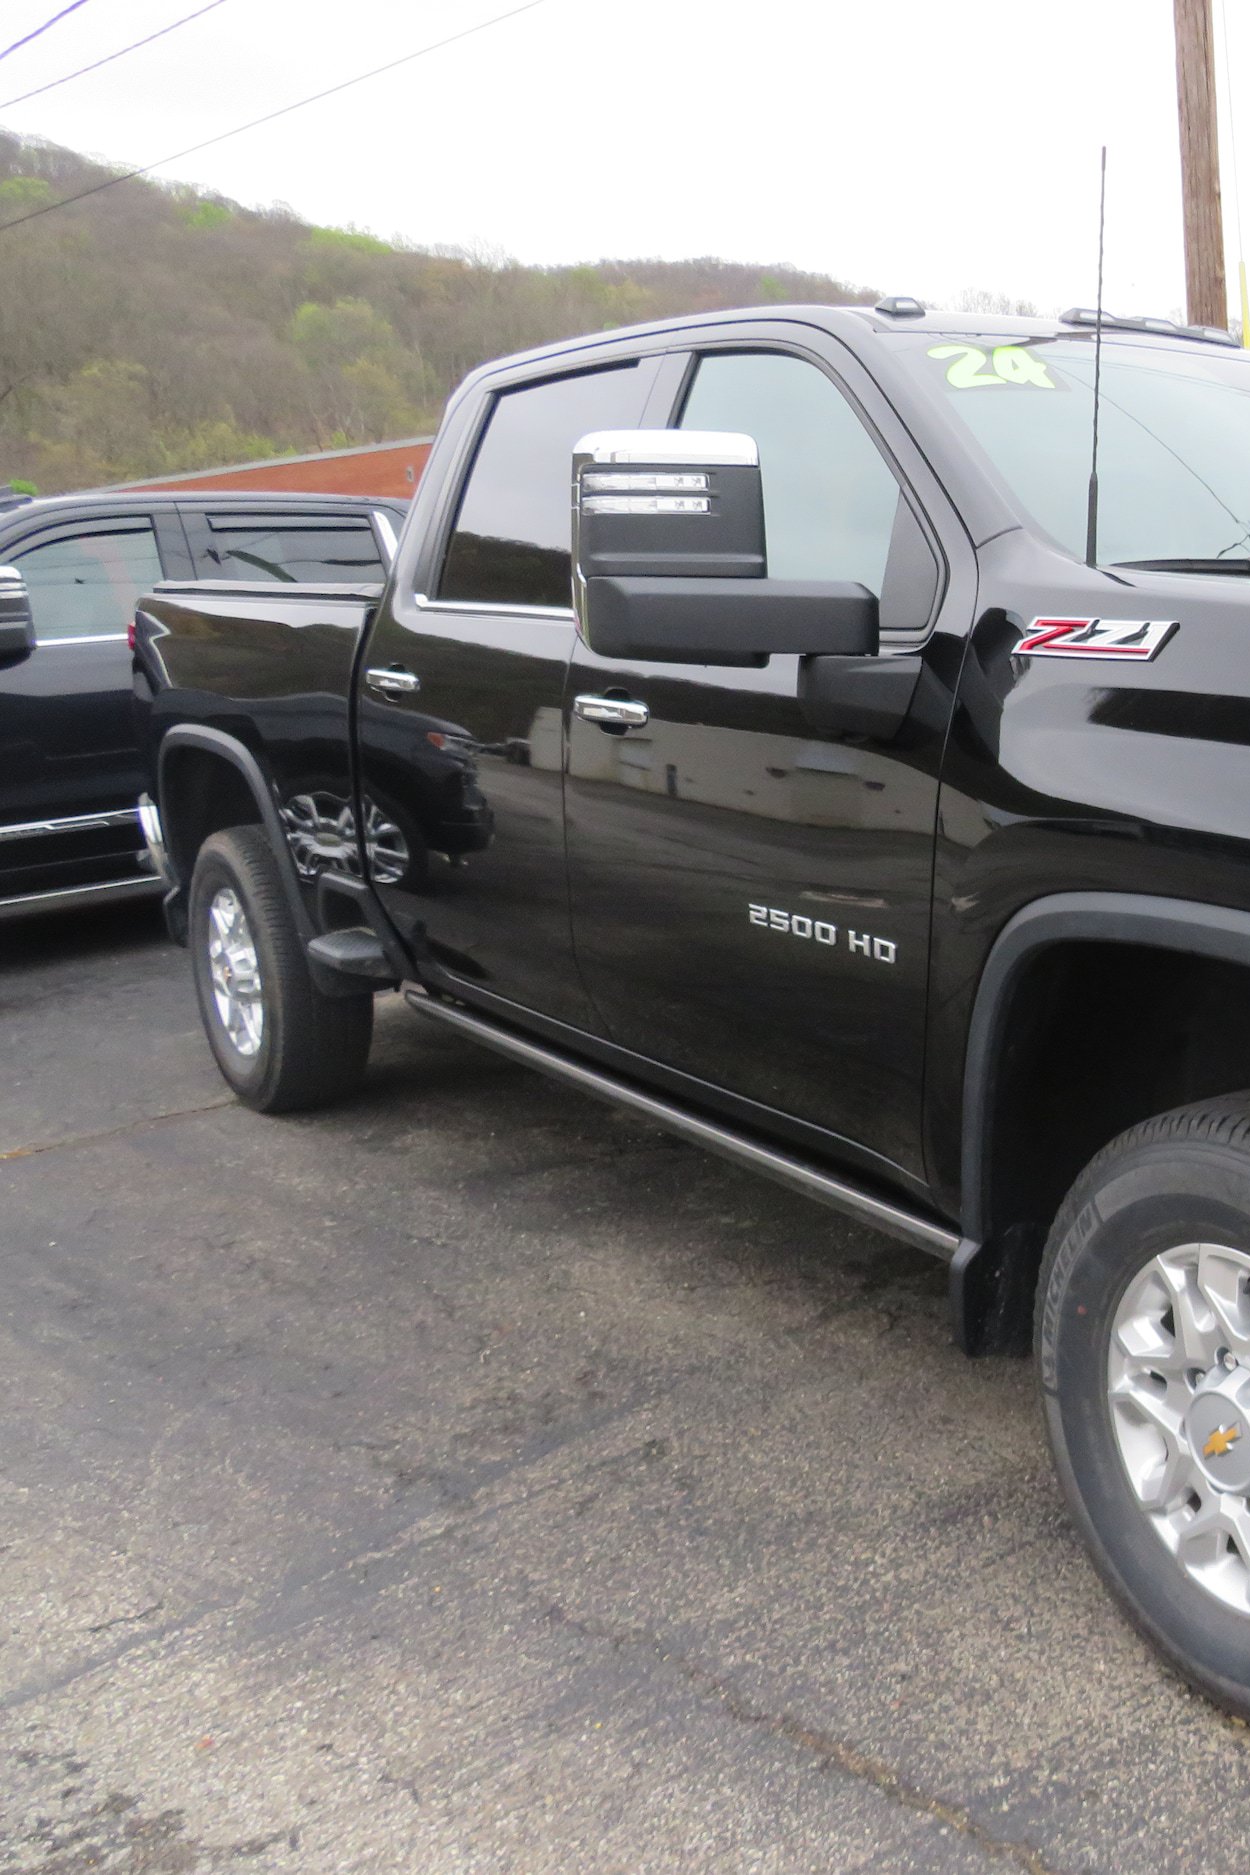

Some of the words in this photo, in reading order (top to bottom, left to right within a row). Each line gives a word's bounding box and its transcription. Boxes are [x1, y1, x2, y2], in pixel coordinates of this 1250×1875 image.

[926, 344, 1057, 390] 24
[1011, 616, 1180, 662] Z71
[748, 902, 837, 947] 2500
[847, 929, 897, 965] HD
[1042, 1201, 1098, 1346] MICHELIN
